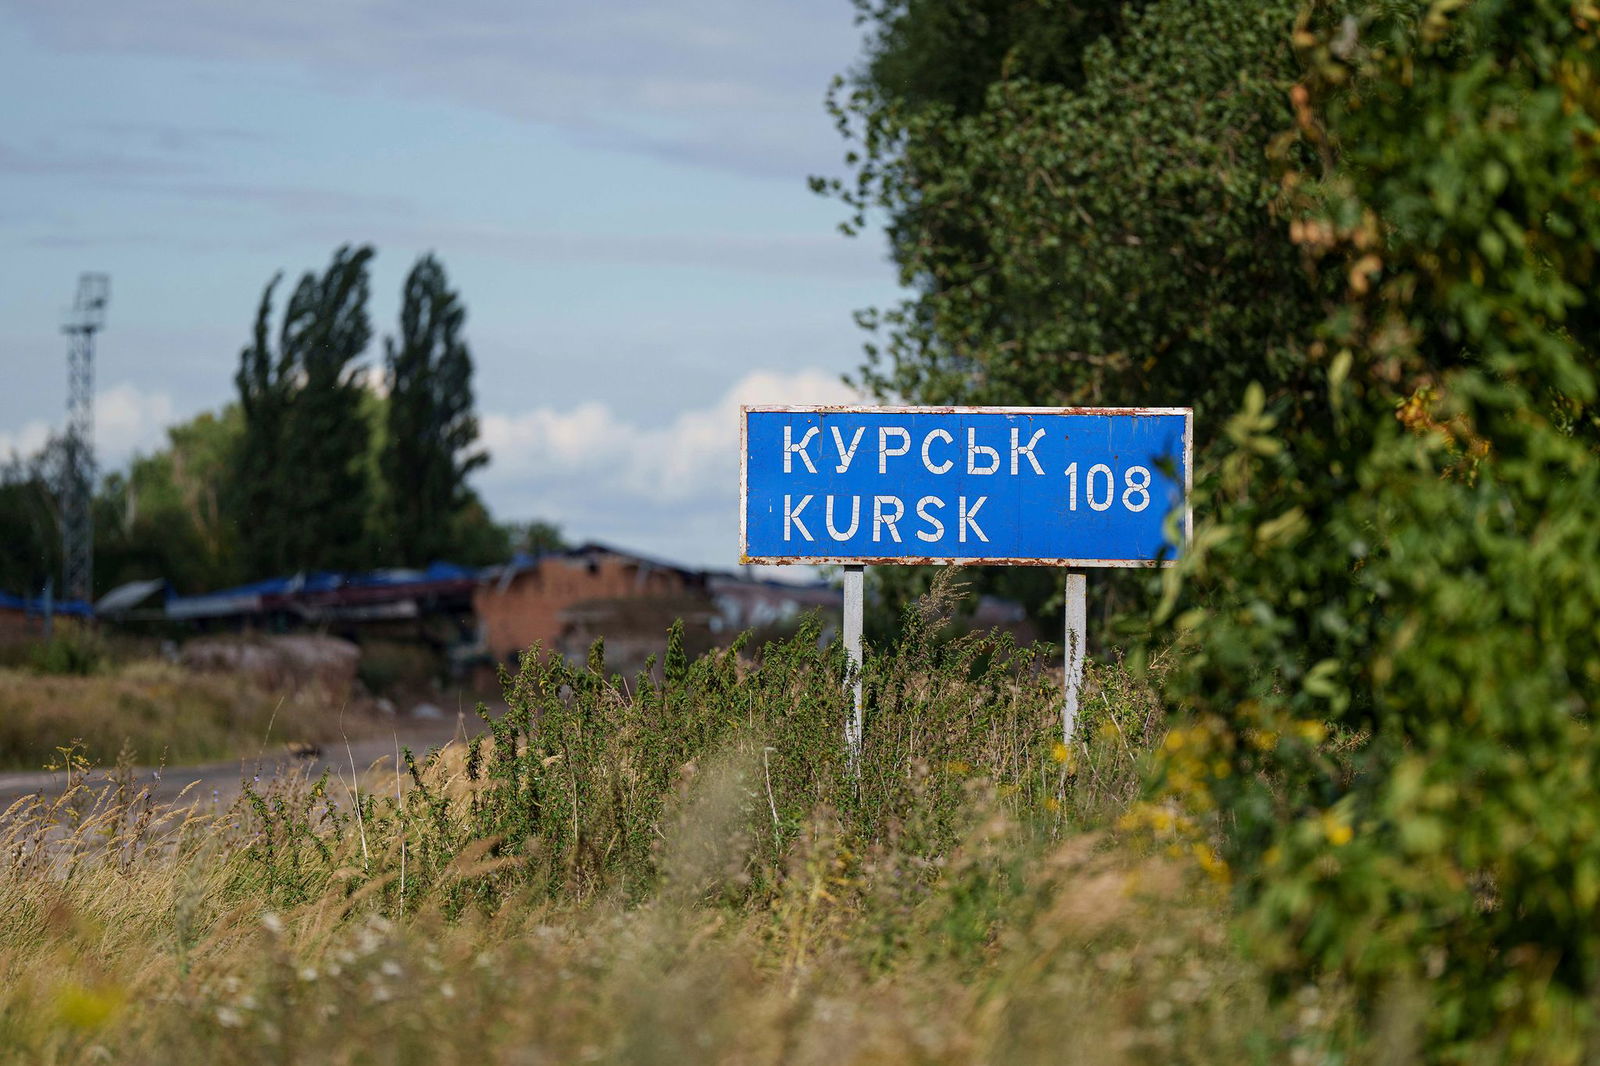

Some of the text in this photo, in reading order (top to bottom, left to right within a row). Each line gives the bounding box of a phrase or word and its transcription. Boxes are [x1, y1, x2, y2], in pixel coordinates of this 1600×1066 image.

[783, 425, 1046, 475] КУРСЬК
[1064, 462, 1151, 513] 108
[783, 494, 990, 543] KURSK
